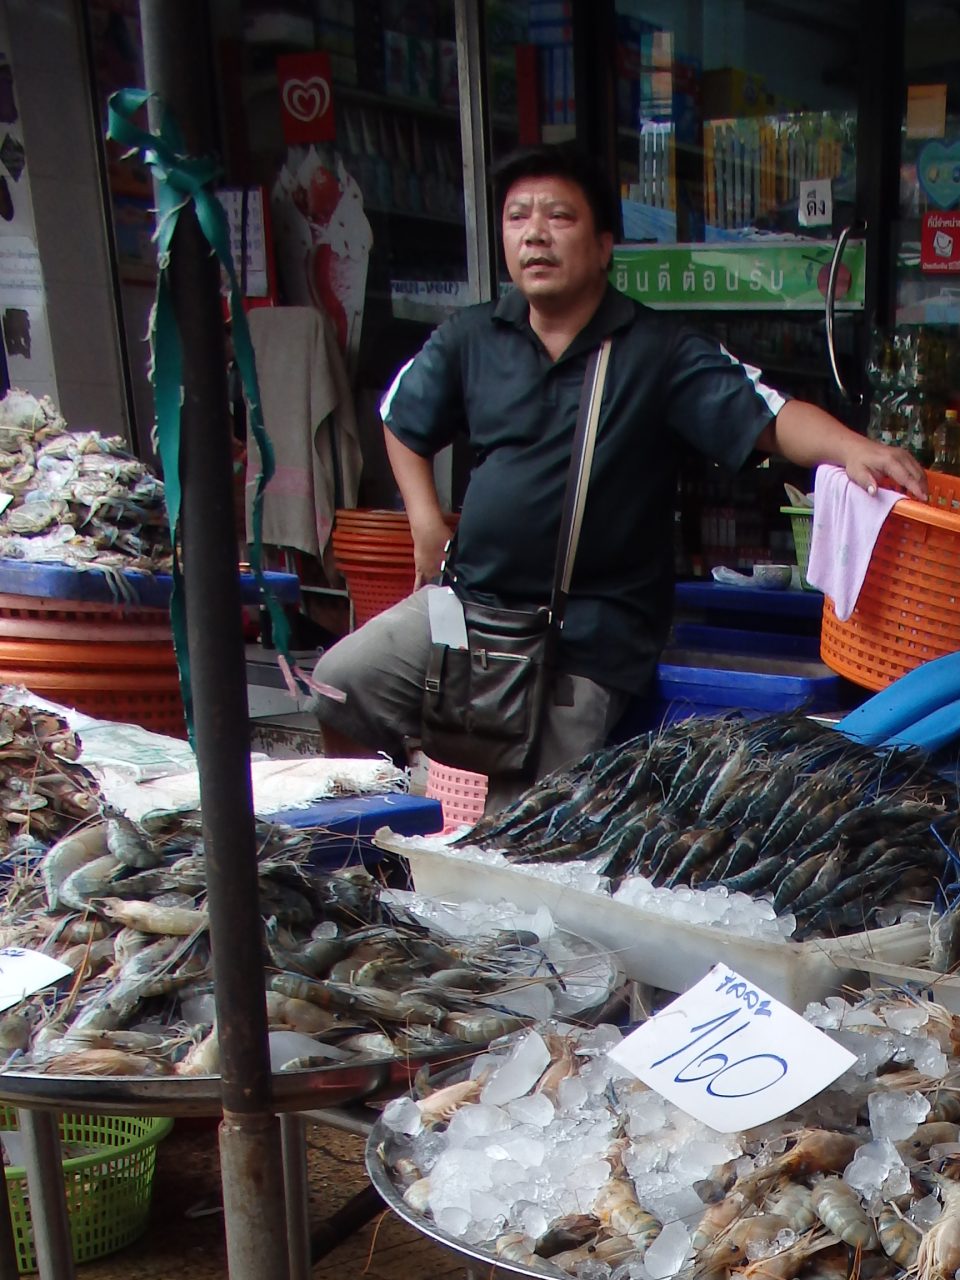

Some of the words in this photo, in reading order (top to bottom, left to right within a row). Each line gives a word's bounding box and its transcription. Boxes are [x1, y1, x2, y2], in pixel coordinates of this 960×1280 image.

[806, 190, 826, 216] ดึง
[616, 262, 785, 293] ยินดีต้อนรับ
[650, 1007, 789, 1098] 160
